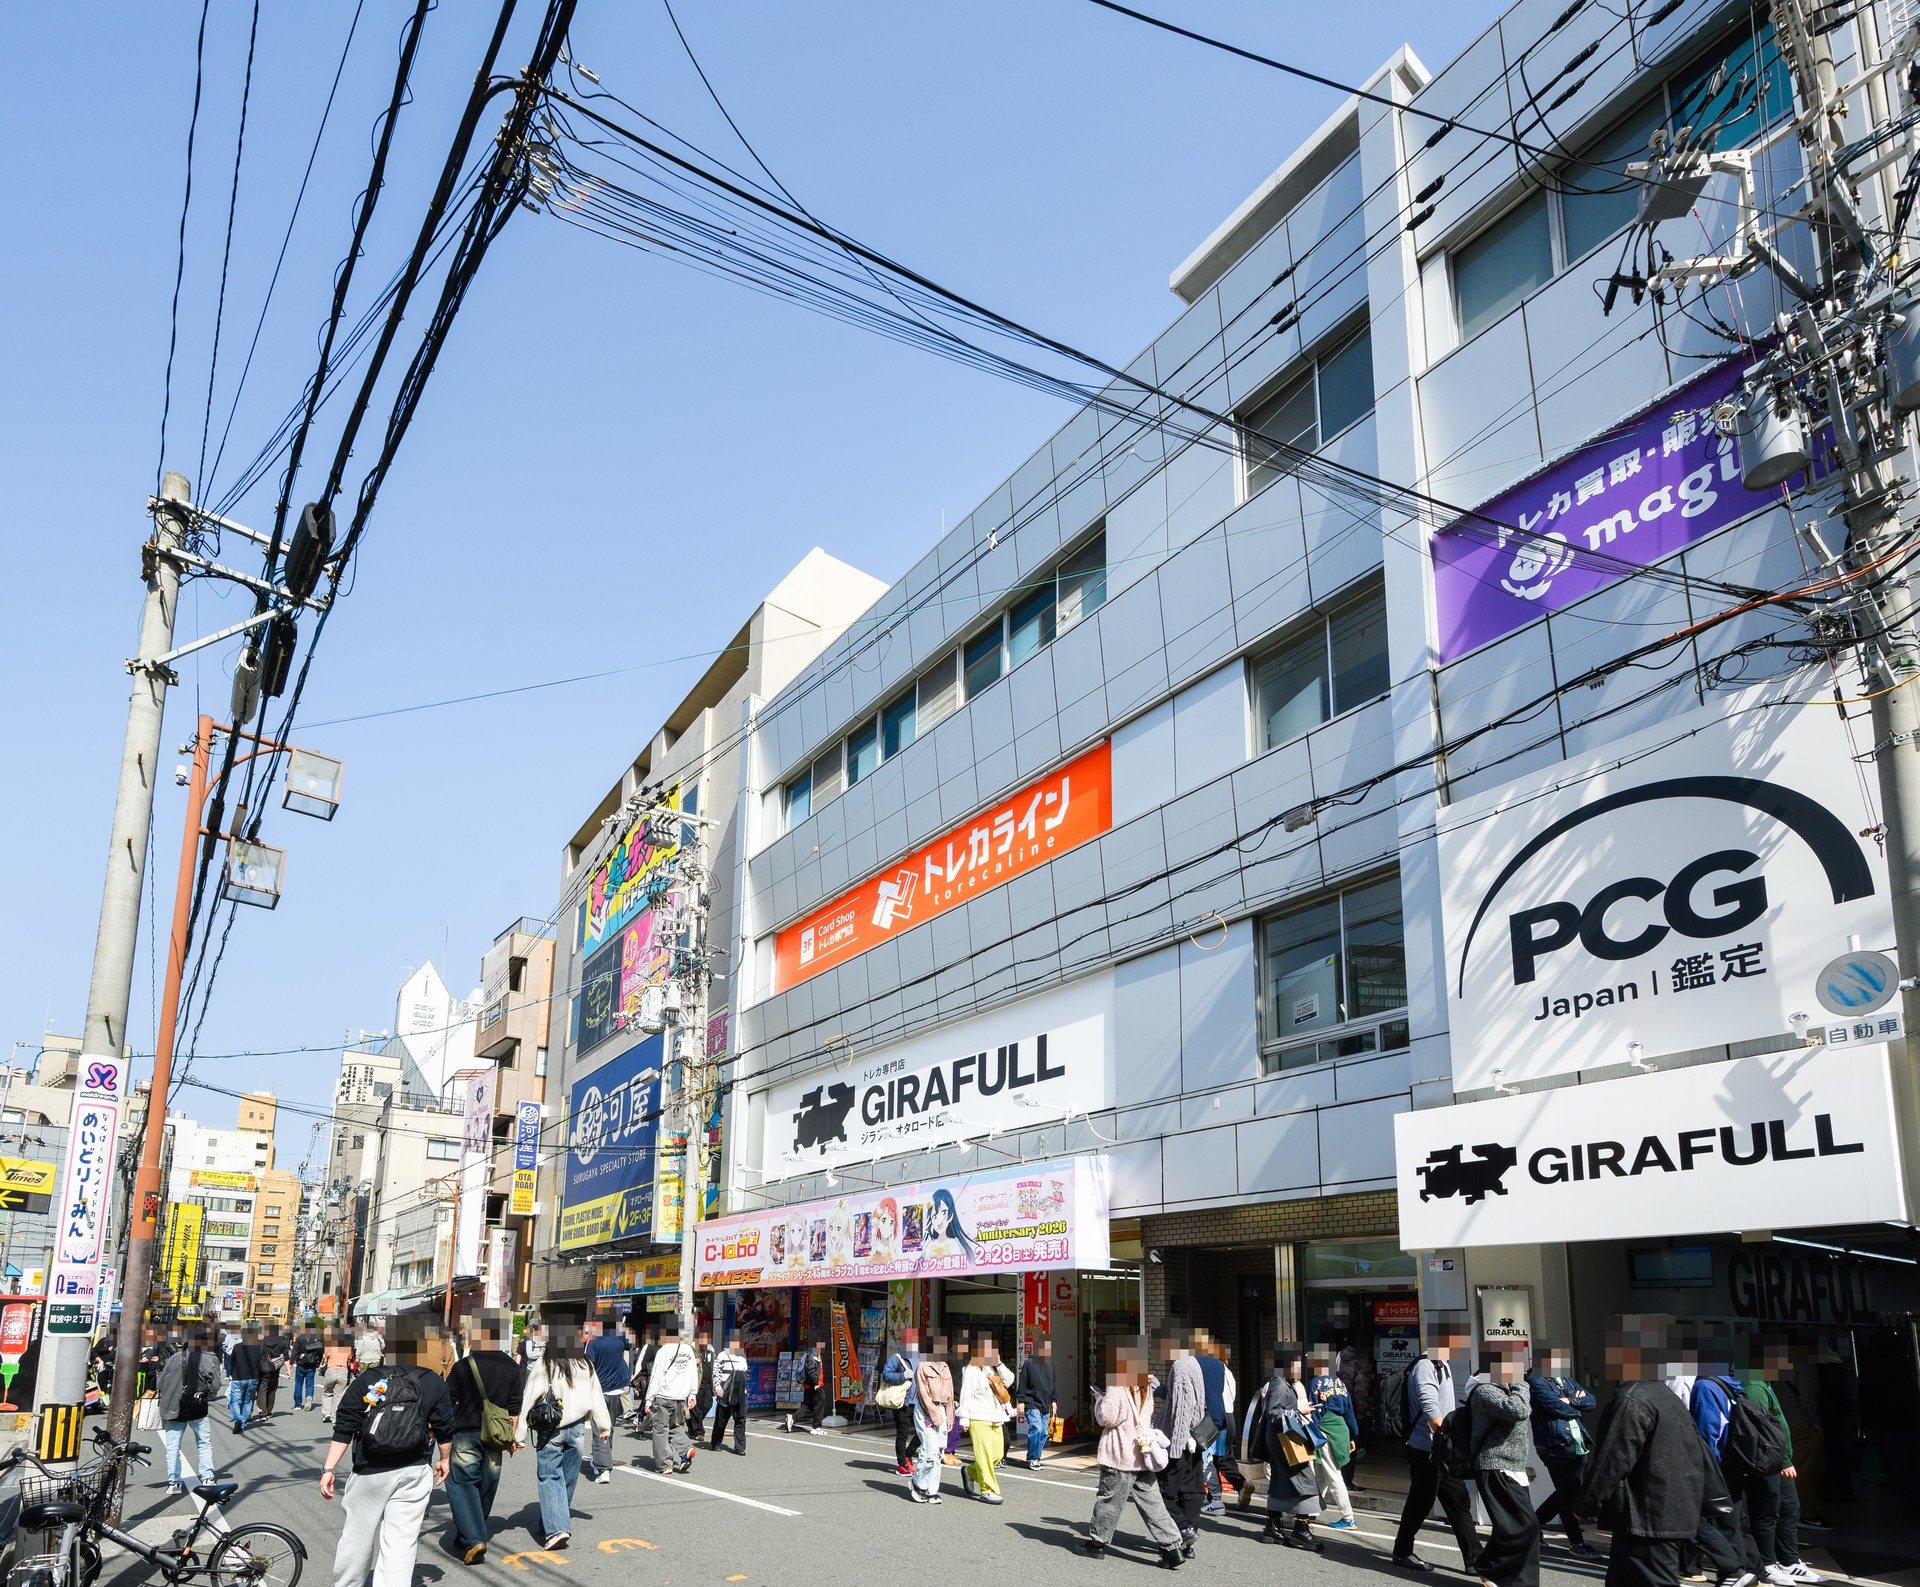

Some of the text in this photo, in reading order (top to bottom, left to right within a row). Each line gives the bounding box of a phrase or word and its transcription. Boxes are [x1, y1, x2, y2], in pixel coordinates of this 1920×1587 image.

[925, 776, 1070, 894] トレカライン
[934, 836, 1055, 905] torecaline
[818, 909, 855, 937] Card Shop
[1509, 849, 1768, 985] PCG
[801, 937, 814, 954] 3F
[818, 924, 854, 950] トレカ専門店
[1534, 942, 1767, 1021] Japan 鑑定
[1829, 1018, 1900, 1043] 自動車
[861, 1033, 1066, 1127] GIRAFULL
[863, 1058, 906, 1081] トレカ専門店
[1528, 1114, 1864, 1185] GIRAFULL
[6, 1170, 43, 1184] Times
[68, 1112, 98, 1238] めいどりーみん
[518, 1173, 532, 1182] OTA
[573, 1148, 647, 1185] SURUGAYA SPECIALTY STORE
[515, 1181, 534, 1190] ROAD
[976, 1220, 1067, 1243] Anniversary 2026
[705, 1241, 758, 1261] C-labo
[700, 1267, 764, 1287] GAMERS
[1729, 1252, 1877, 1324] GIRAFULL
[1390, 1307, 1418, 1315] トレカライン
[1486, 1328, 1529, 1337] GIRAFULL
[1382, 1350, 1417, 1359] GIRAFULL
